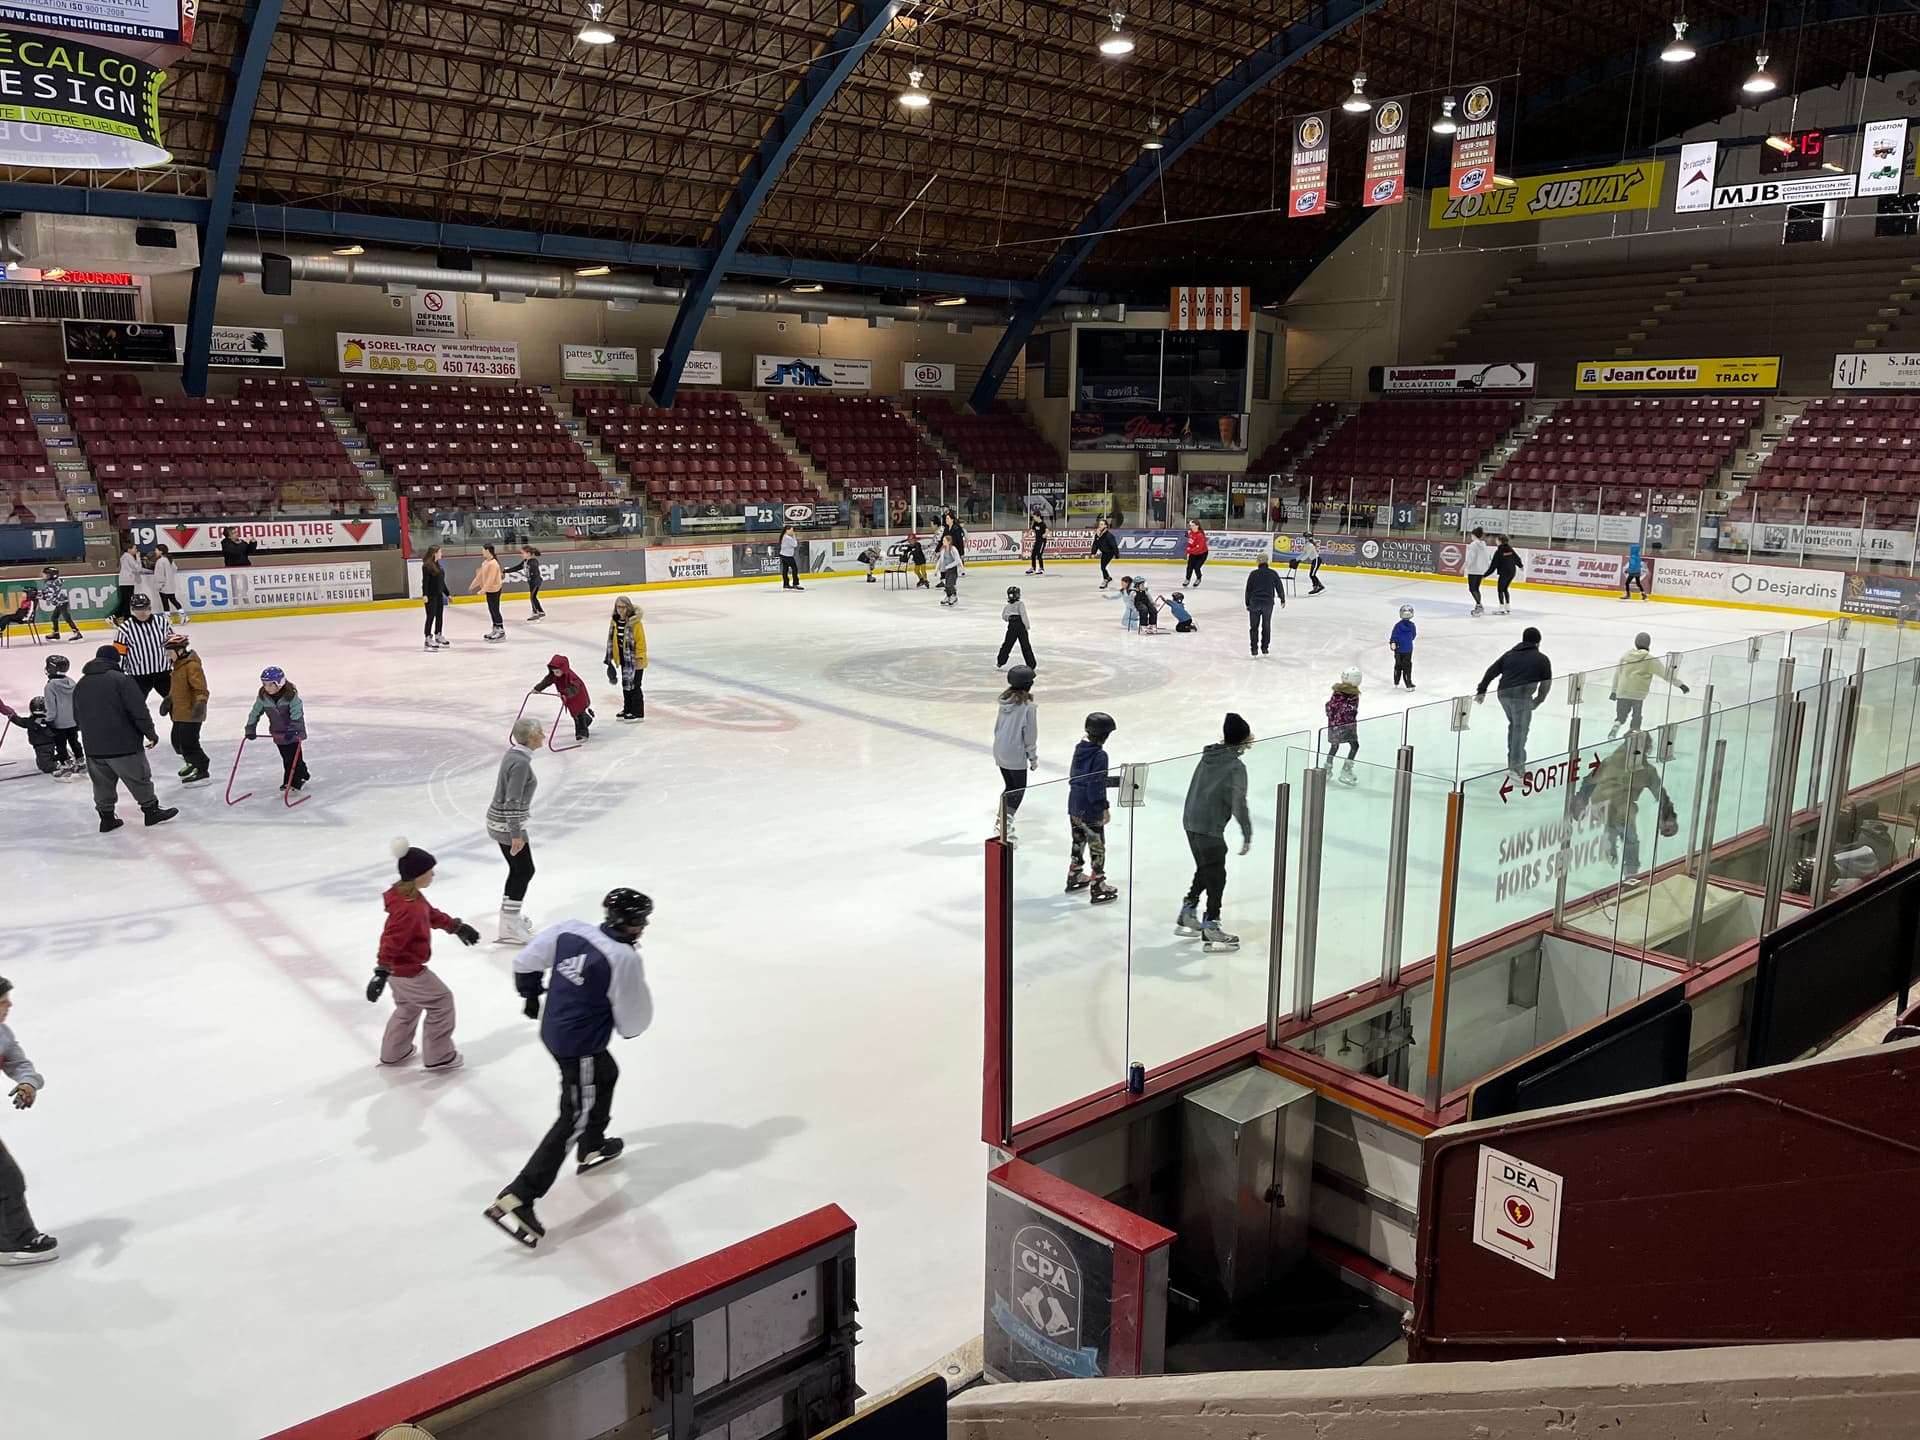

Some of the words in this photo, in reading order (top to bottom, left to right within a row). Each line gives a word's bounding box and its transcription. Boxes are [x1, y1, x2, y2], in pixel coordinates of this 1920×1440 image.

[69, 2, 83, 12] ISO
[0, 70, 136, 117] ESIGN
[31, 111, 80, 127] VOTRE
[1456, 120, 1496, 140] CHAMPIONS
[1868, 123, 1903, 132] LOCATION
[1370, 134, 1406, 153] CHAMPIONS
[1293, 149, 1327, 166] CHAMPIONS
[1442, 187, 1519, 220] ZONE
[1528, 169, 1644, 215] SUBWAY
[1717, 184, 1780, 206] MJB
[1782, 182, 1836, 192] CONSTRUCTION
[42, 268, 131, 286] STAURANT
[1179, 293, 1240, 303] AUVENTS
[417, 312, 453, 322] DÉFENSE
[1181, 307, 1232, 318] SIMARD
[415, 319, 426, 327] DE
[428, 320, 455, 328] FUMER
[368, 341, 436, 353] SOREL-TRACY
[565, 350, 593, 360] pattes
[606, 351, 635, 361] griffes
[369, 356, 437, 372] BAR-B-Q
[442, 360, 463, 374] 450
[466, 362, 516, 375] 743-3366
[1715, 372, 1759, 383] TRACY
[1392, 381, 1452, 389] EXCAVATION
[759, 509, 773, 523] 23
[789, 508, 809, 518] ESI
[1398, 510, 1412, 523] 31
[1443, 511, 1458, 526] 33
[298, 522, 333, 536] TIRE
[440, 519, 457, 536] 21
[475, 517, 530, 529] EXCELLENCE
[556, 515, 607, 527] EXCELLENCE
[622, 512, 637, 528] 21
[32, 529, 55, 549] 17
[130, 527, 155, 545] 19
[210, 535, 335, 549] SL-TRACY
[1117, 536, 1179, 550] MS
[1791, 528, 1853, 548] Mongeon
[1871, 538, 1895, 550] Fils
[1382, 541, 1432, 554] COMPTOIR
[1382, 550, 1433, 562] PRESTIGE
[568, 563, 602, 572] Assurances
[668, 562, 708, 578] VITRERIE
[1577, 560, 1619, 573] PINARD
[1657, 567, 1724, 580] SOREL-TRACY
[187, 573, 249, 608] CSR
[253, 569, 334, 584] ENTREPRENEUR
[1656, 576, 1691, 587] NISSAN
[1757, 577, 1837, 599] Desjardins
[254, 590, 318, 604] COMMERCIAL
[1521, 758, 1582, 797] SORTIE
[1499, 829, 1534, 865] SANS
[1537, 818, 1573, 852] NOUS
[1496, 858, 1541, 903] HORS
[1503, 1165, 1540, 1192] DEA
[1020, 1250, 1071, 1293] CPA
